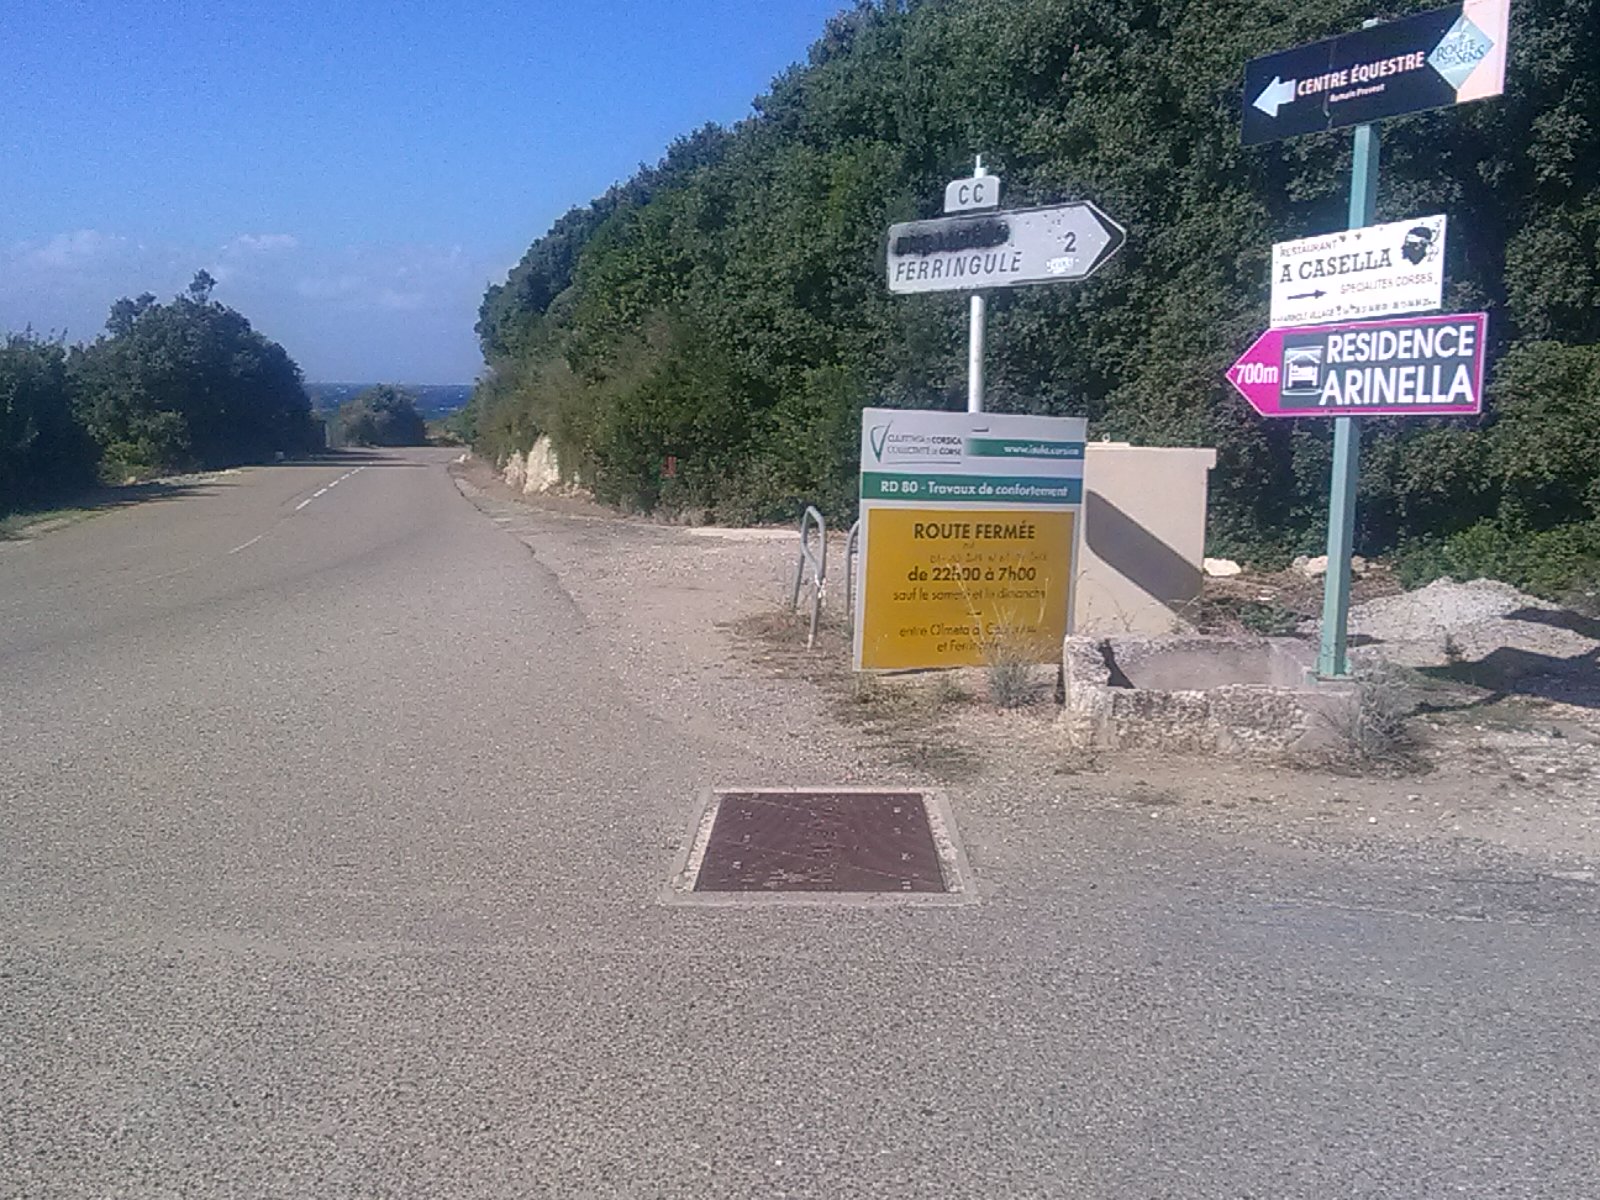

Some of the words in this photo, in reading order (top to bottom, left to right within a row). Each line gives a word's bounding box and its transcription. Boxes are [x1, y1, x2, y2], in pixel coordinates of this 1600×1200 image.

[1297, 69, 1350, 96] CENTRE
[1350, 51, 1426, 83] ÉQUESTRE
[1063, 231, 1077, 253] 2
[894, 252, 1023, 282] FERRINGULE
[1280, 263, 1293, 283] A
[1298, 248, 1393, 280] CASELLA
[1395, 272, 1433, 287] CORSES
[1326, 325, 1476, 363] RESIDENCE
[1236, 362, 1279, 384] 700m
[1319, 363, 1475, 406] ARINELLA
[931, 435, 963, 445] CORSICA
[880, 480, 899, 493] RD
[901, 481, 918, 493] 80
[928, 481, 976, 495] Travaux
[978, 482, 994, 495] de
[995, 483, 1068, 497] confortement
[914, 523, 970, 539] ROUTE
[975, 520, 1036, 539] FERMÉE
[907, 567, 928, 581] de
[932, 567, 981, 581] 22h00
[984, 566, 995, 581] à
[998, 567, 1037, 581] 7h00
[893, 587, 917, 600] sauf
[918, 587, 928, 600] le
[899, 625, 928, 637] entre
